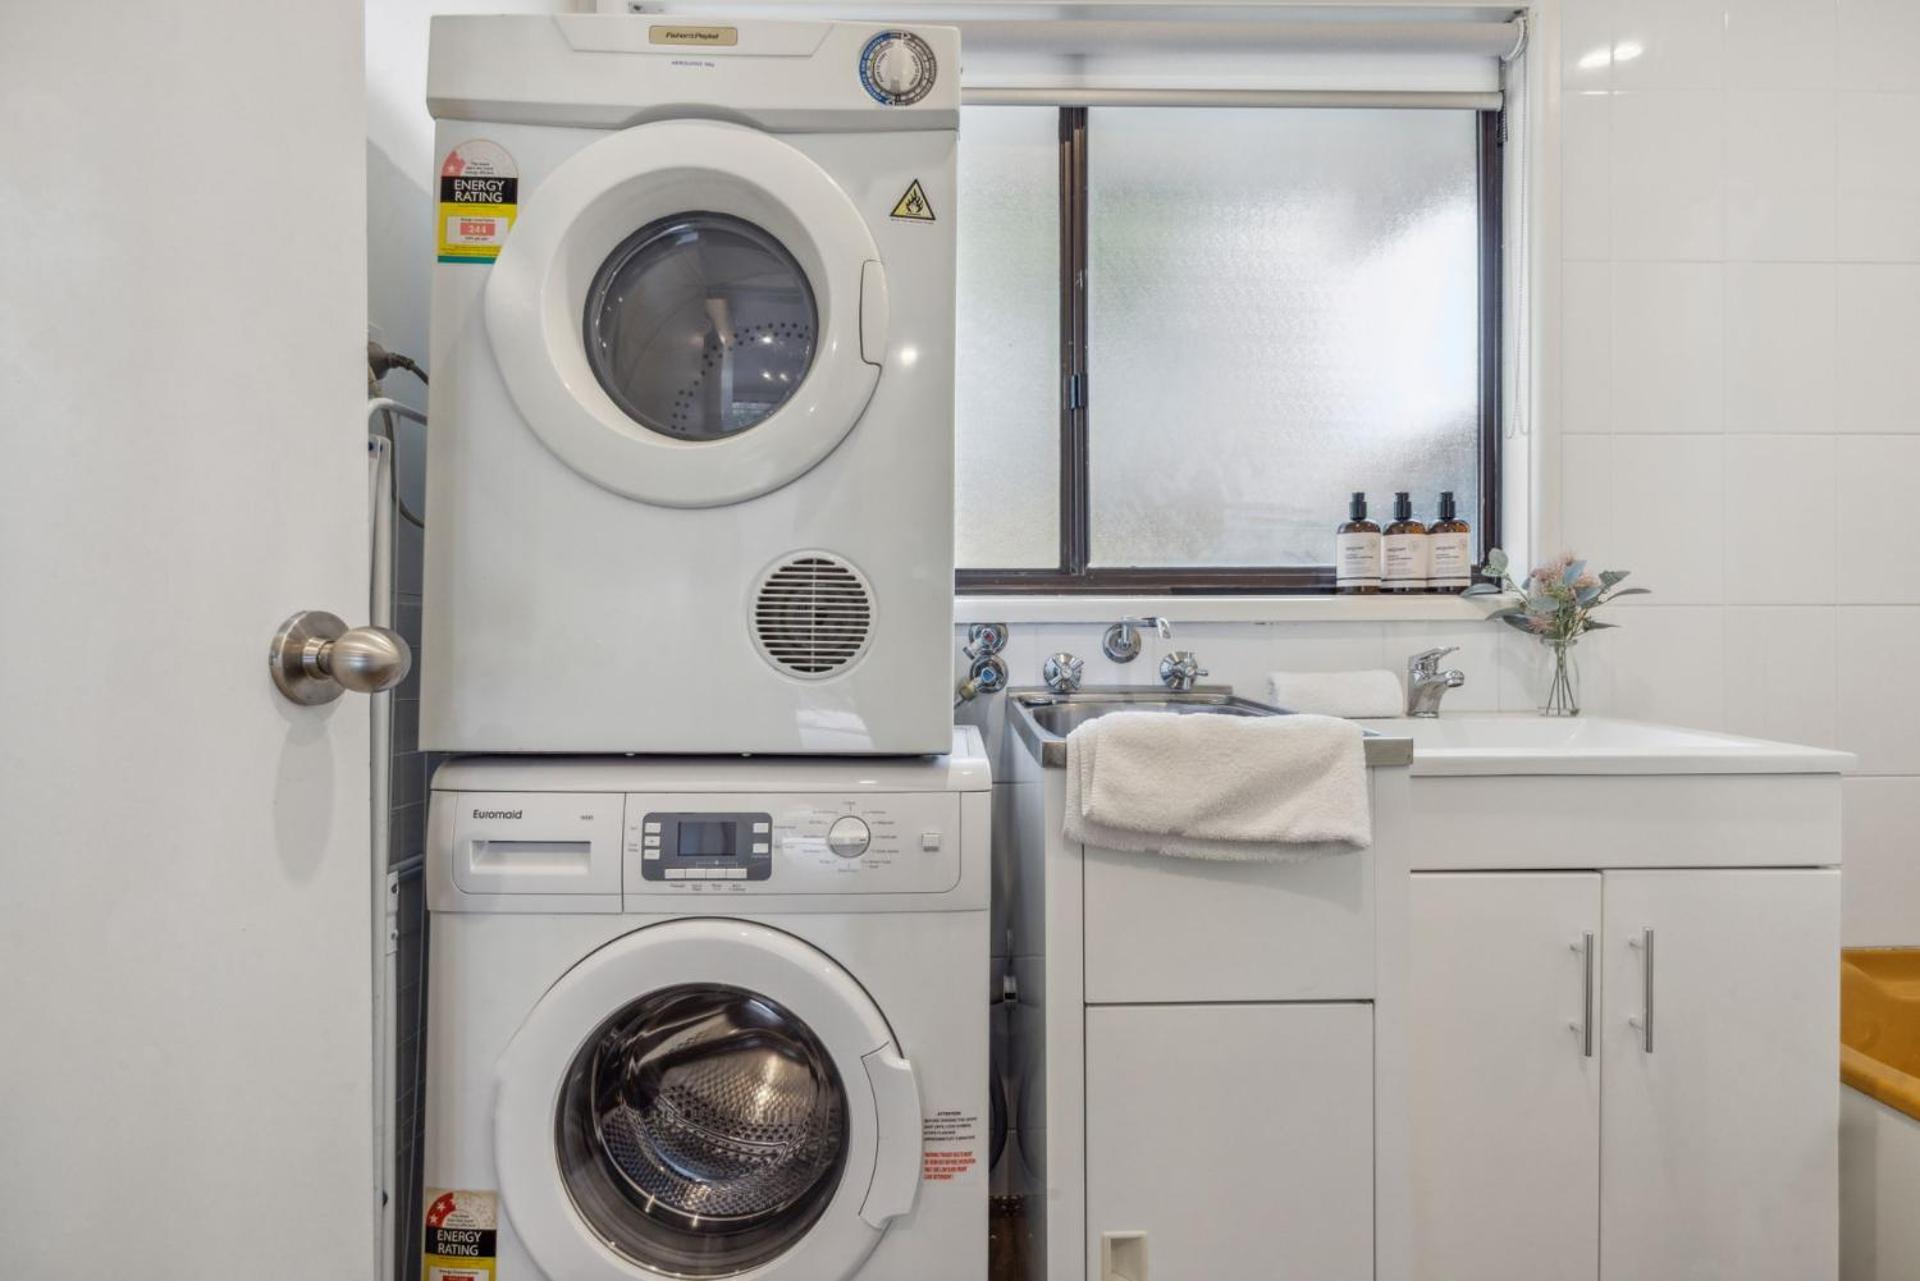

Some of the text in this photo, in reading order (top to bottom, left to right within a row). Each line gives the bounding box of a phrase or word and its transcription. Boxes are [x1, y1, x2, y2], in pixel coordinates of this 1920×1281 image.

[454, 179, 505, 191] ENERGY
[454, 191, 503, 203] RATING
[472, 808, 523, 820] Euromaid
[437, 1229, 482, 1243] ENERGY
[437, 1243, 479, 1256] RATING
